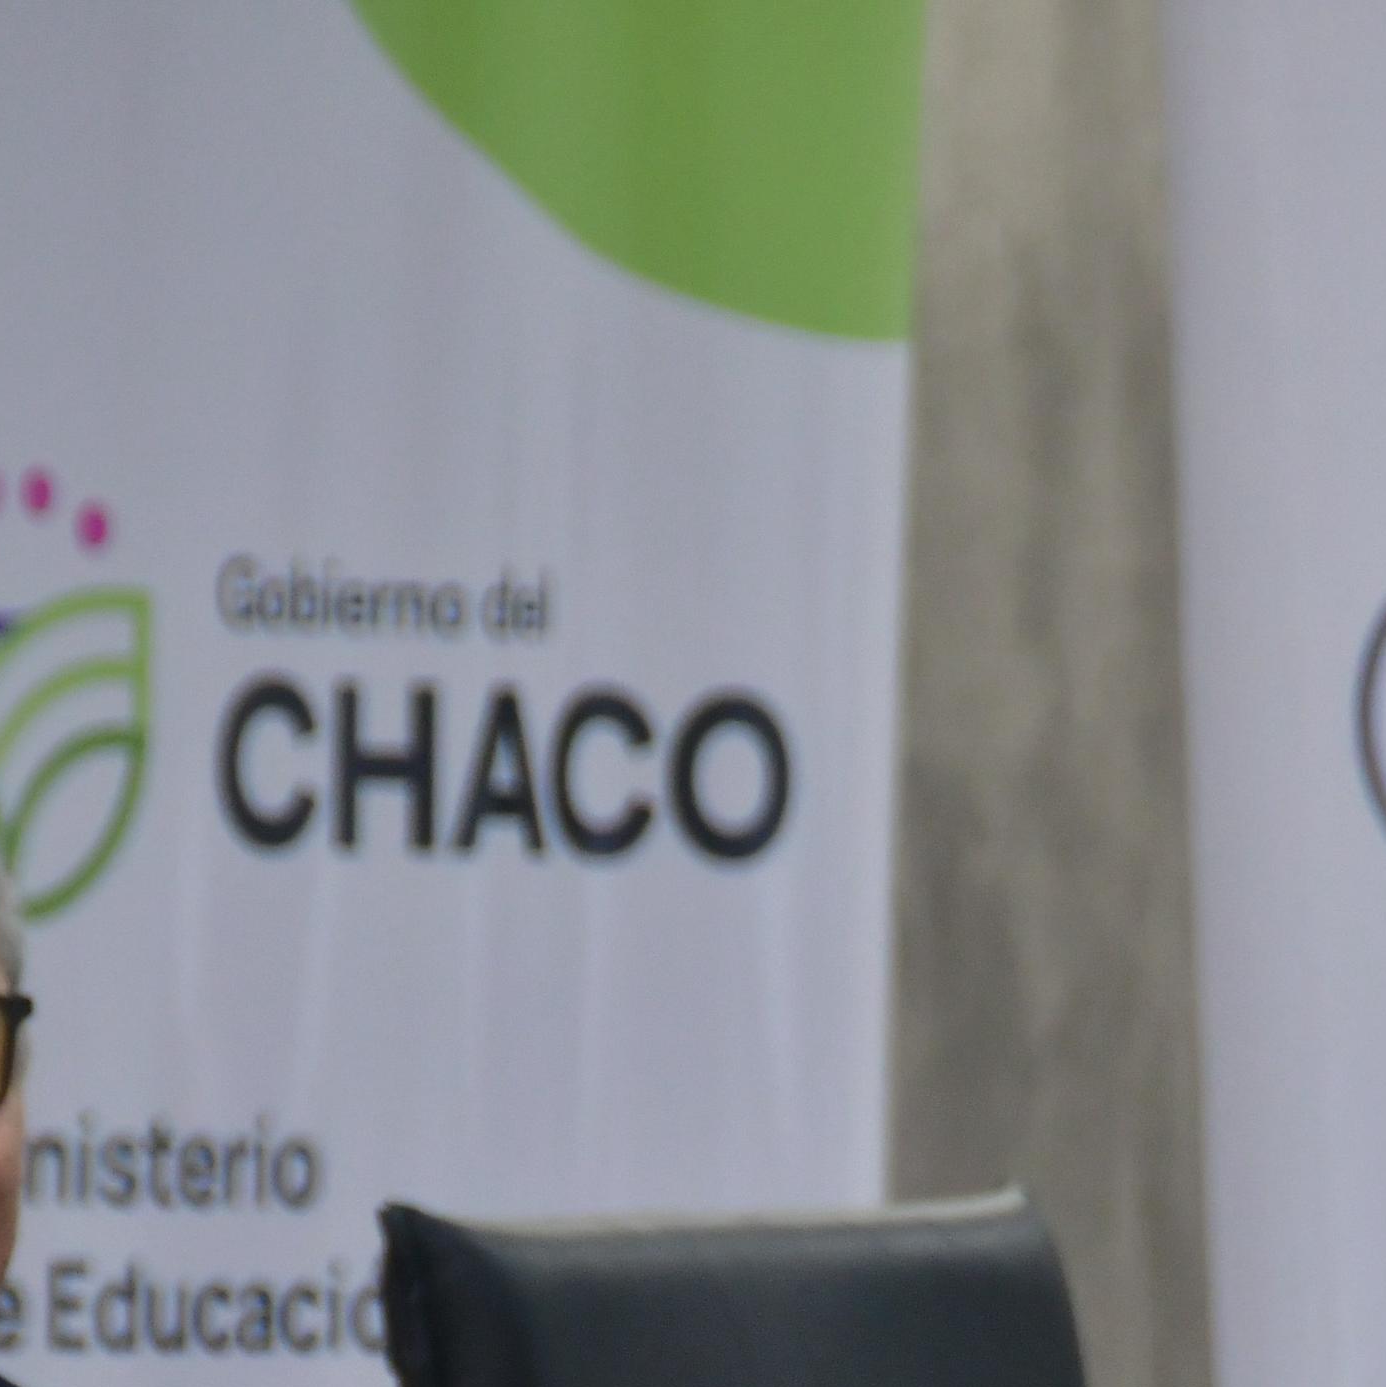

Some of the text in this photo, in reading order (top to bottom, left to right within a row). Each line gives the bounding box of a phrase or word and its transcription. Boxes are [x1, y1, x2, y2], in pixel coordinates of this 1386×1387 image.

[215, 553, 551, 642] Gobierno del
[217, 672, 793, 868] CHACO
[22, 1110, 323, 1210] nisterio
